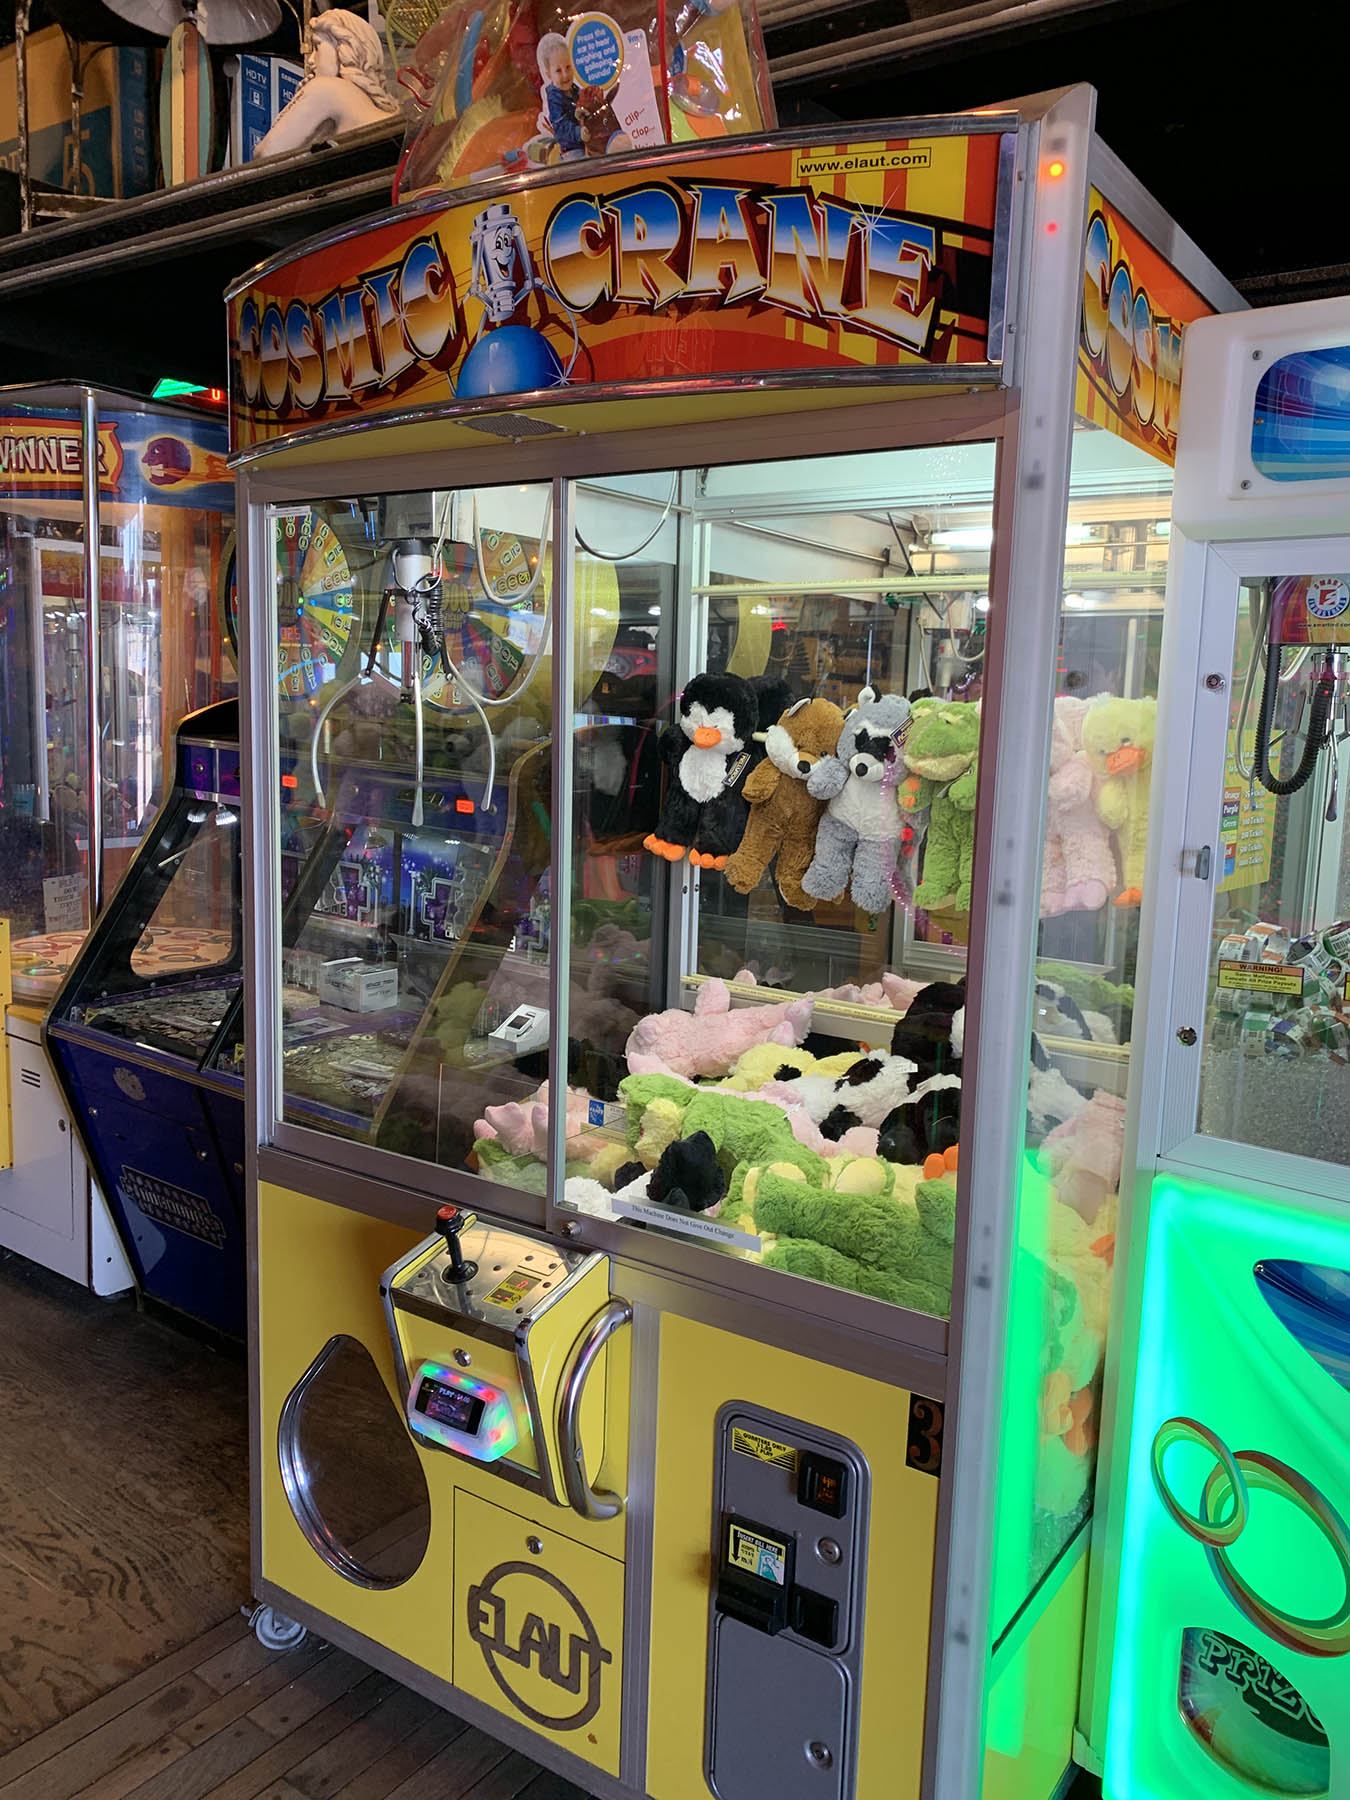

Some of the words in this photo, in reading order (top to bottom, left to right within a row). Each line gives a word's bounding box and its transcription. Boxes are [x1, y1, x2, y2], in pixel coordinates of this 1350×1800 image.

[246, 67, 266, 84] HDTV
[282, 88, 294, 100] HD
[799, 154, 928, 174] www.elaut.com
[239, 232, 458, 411] COSMIC
[543, 182, 938, 356] CRANE
[1223, 804, 1239, 815] Purple
[1222, 819, 1237, 829] Green
[1240, 964, 1283, 973] WARNING!
[632, 1204, 643, 1213] This
[643, 1207, 665, 1219] Machine
[665, 1214, 679, 1224] Does
[679, 1218, 689, 1227] Not
[690, 1221, 703, 1231] Give
[703, 1224, 714, 1234] Out
[714, 1228, 735, 1240] Change
[743, 1432, 771, 1447] QUARTERS
[772, 1443, 787, 1453] ONLY
[909, 1399, 943, 1472] 3
[737, 1530, 755, 1544] INSERT
[754, 1538, 765, 1549] BILL
[765, 1543, 779, 1555] HERE
[467, 1584, 612, 1695] ELAUT
[1199, 1633, 1320, 1729] Priz
